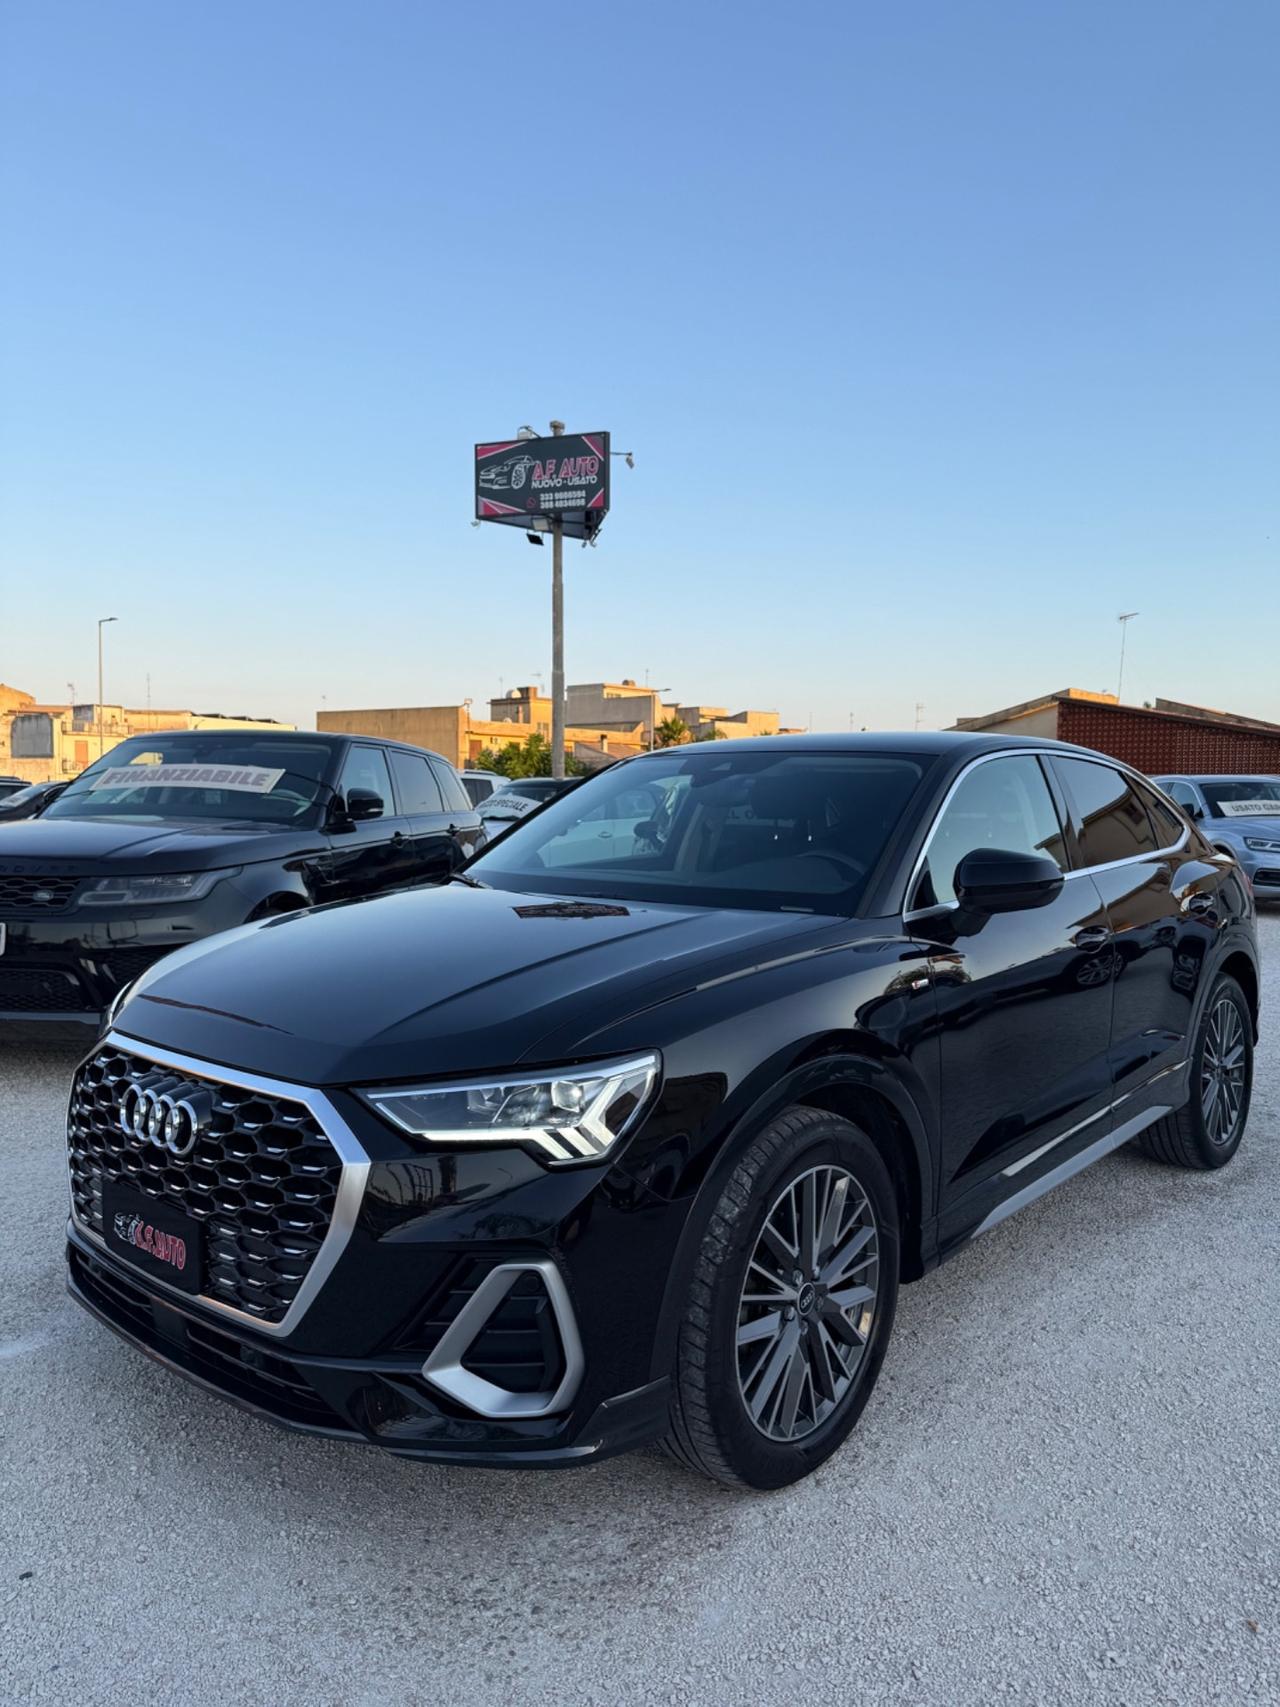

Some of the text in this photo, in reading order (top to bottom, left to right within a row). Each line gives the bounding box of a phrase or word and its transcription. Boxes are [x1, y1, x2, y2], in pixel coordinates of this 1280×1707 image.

[558, 455, 600, 478] AUTO
[567, 475, 598, 486] USATO
[103, 767, 270, 786] FINANZIABILE
[152, 1229, 187, 1270] AUTO
